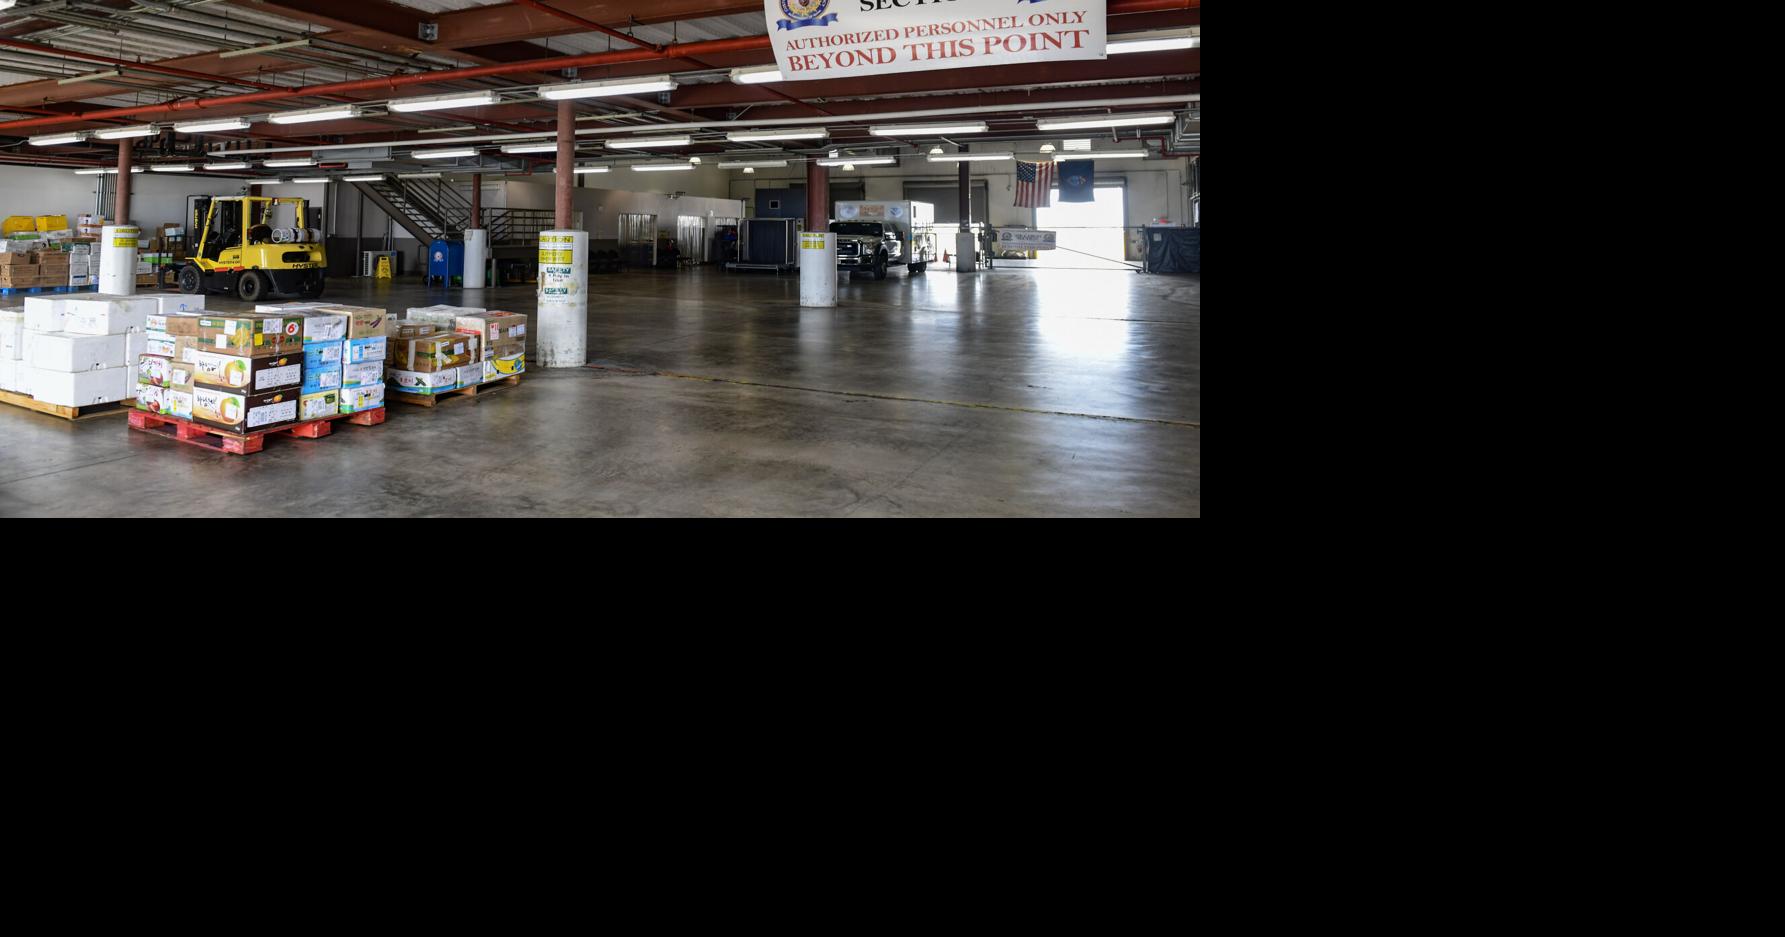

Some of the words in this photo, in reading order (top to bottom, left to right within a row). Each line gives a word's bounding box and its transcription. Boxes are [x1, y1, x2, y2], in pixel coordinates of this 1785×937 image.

[786, 28, 899, 50] AUTHORIZED
[904, 15, 1024, 39] PERSONNEL
[1028, 10, 1087, 27] ONLY
[787, 46, 898, 72] BEYOND
[902, 38, 976, 62] THIS
[983, 29, 1090, 55] POINT
